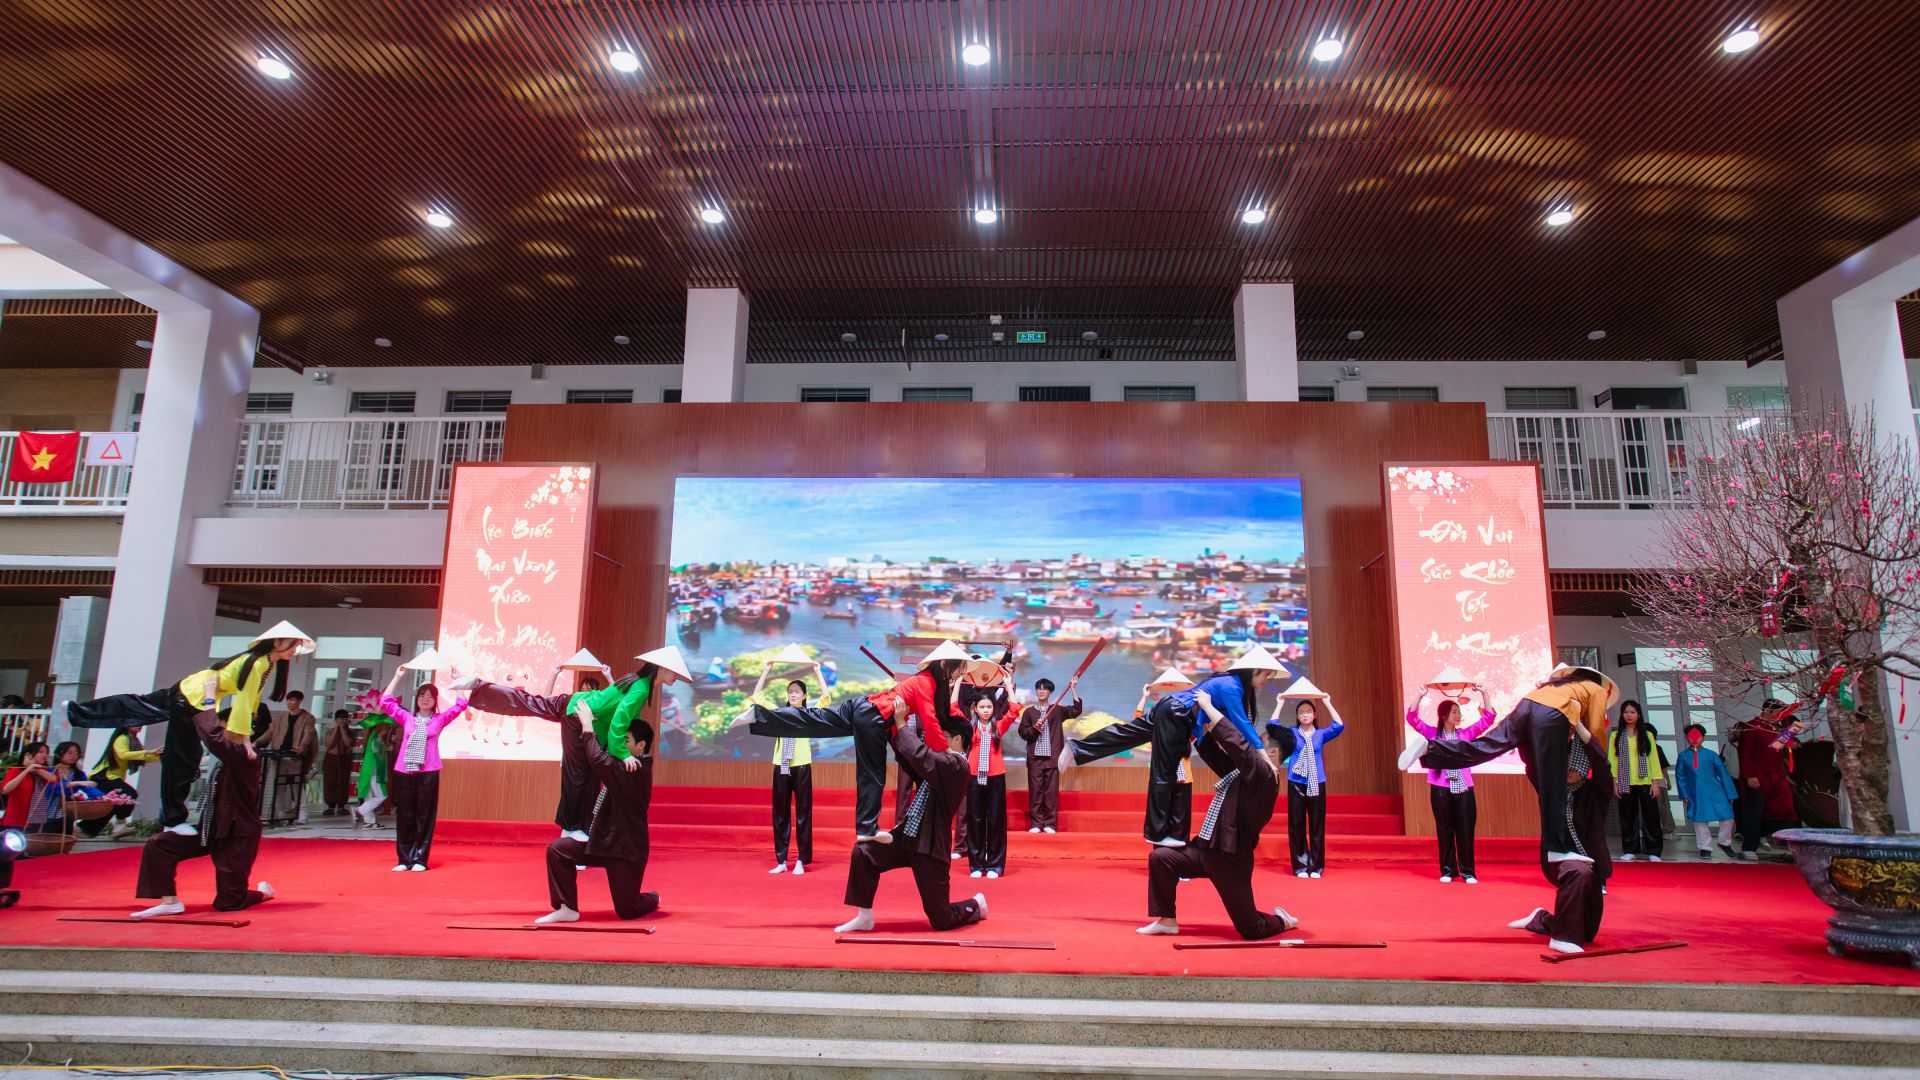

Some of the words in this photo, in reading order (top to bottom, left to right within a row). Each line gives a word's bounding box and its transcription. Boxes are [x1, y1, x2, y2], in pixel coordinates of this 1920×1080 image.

[1477, 515, 1513, 547] Vui
[475, 548, 506, 580] Mai
[1420, 557, 1454, 583] Sức
[506, 624, 557, 651] Phúc
[1422, 630, 1452, 655] An
[1455, 631, 1526, 664] Khang
